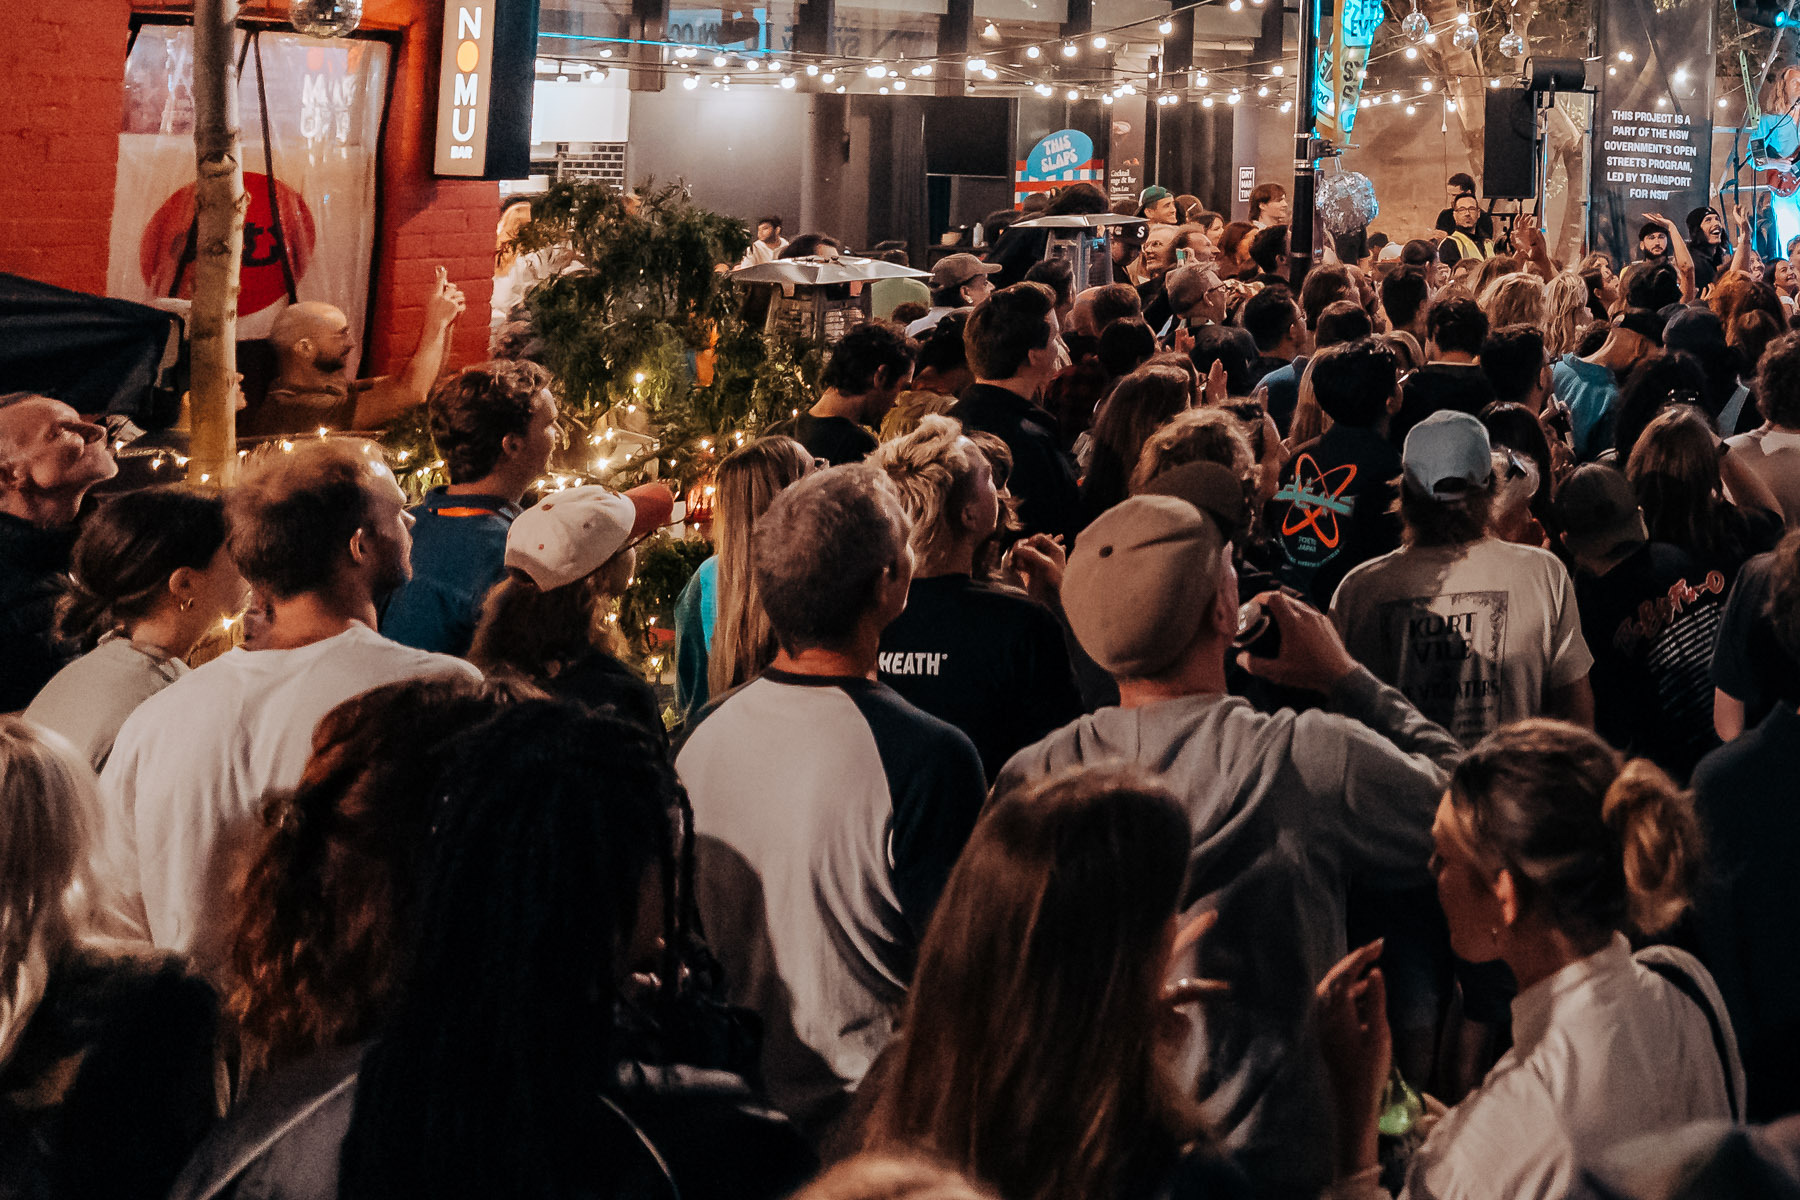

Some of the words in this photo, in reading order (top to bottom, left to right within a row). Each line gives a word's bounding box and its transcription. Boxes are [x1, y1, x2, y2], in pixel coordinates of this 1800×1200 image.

[1612, 110, 1633, 121] THIS
[1635, 111, 1673, 123] PROJECT
[1674, 114, 1684, 125] IS
[1684, 114, 1691, 125] A
[1612, 126, 1637, 136] PART
[1638, 127, 1650, 137] OF
[1651, 128, 1667, 139] THE
[1669, 130, 1689, 140] NSW
[450, 146, 474, 159] BAR
[1042, 135, 1072, 156] THIS
[1604, 141, 1672, 154] GOVERNMENT'S
[1673, 145, 1697, 156] OPEN
[1041, 149, 1078, 172] SLAPS
[1606, 156, 1647, 168] STREETS
[1648, 158, 1693, 173] PROGRAM,
[1241, 170, 1253, 179] DRY
[1607, 171, 1624, 182] LED
[1625, 172, 1638, 183] BY
[1640, 173, 1691, 187] TRANSPORT
[1629, 188, 1648, 199] FOR
[1650, 189, 1669, 201] NSW
[1137, 225, 1145, 238] S
[1410, 612, 1477, 638] KURT
